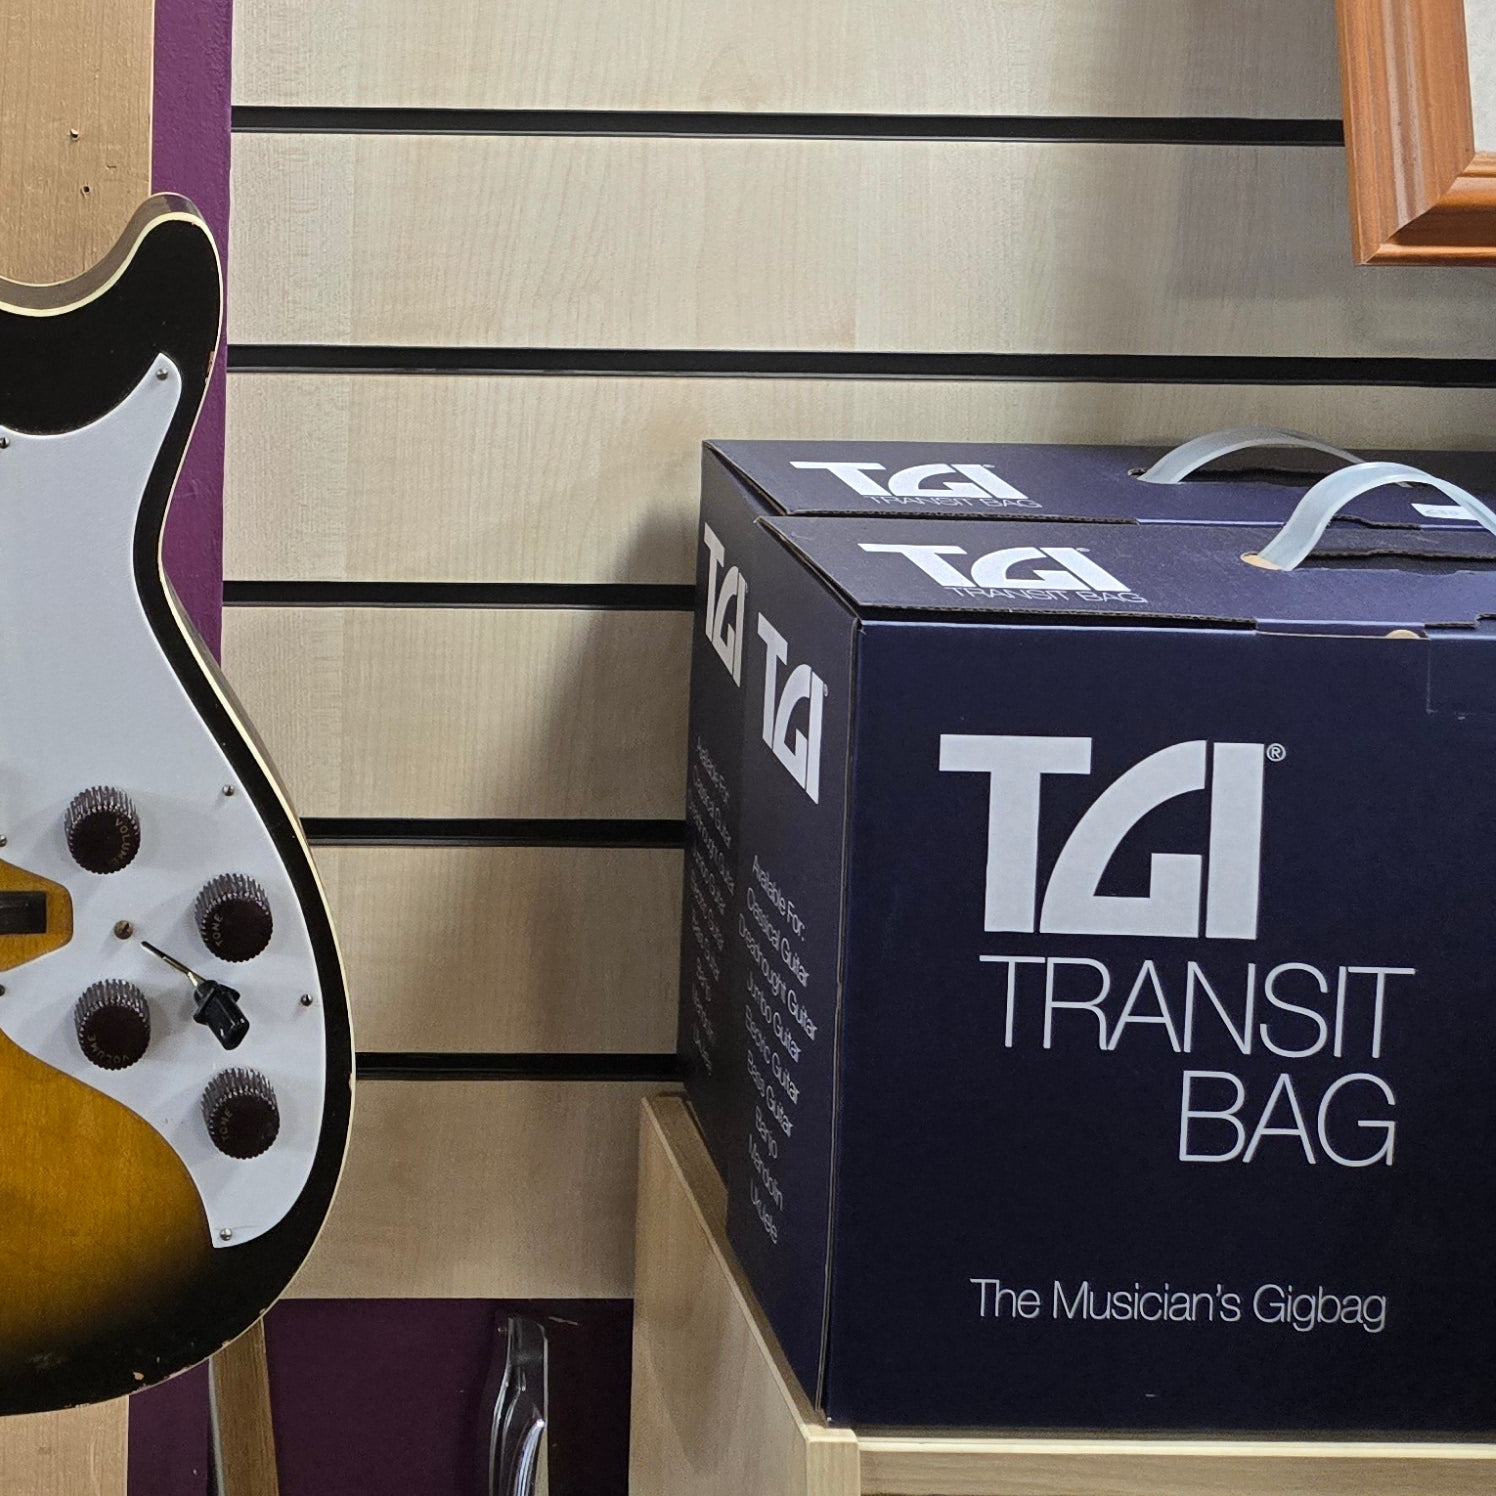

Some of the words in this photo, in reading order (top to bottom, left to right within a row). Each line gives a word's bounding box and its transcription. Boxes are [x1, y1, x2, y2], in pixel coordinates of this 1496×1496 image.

[789, 461, 1029, 501] TGI
[865, 495, 974, 508] TRANSIT
[979, 496, 1042, 509] BAG
[857, 543, 1132, 592] TGI
[704, 521, 746, 688] TGI
[944, 586, 1070, 602] TRANSIT
[1071, 589, 1149, 604] BAG
[757, 612, 824, 805] TGI
[939, 733, 1265, 940] TGI
[211, 913, 223, 947] TONE
[781, 938, 809, 988] Guitar
[788, 989, 818, 1041] Guitar
[979, 954, 1416, 1060] TRANSIT
[773, 1012, 802, 1063] Guitar
[772, 1053, 800, 1104] Guitar
[766, 1085, 794, 1137] Guitar
[1179, 1069, 1396, 1167] BAG
[970, 1278, 1041, 1319] The
[1052, 1280, 1241, 1322] Musician's
[1253, 1283, 1387, 1334] Gigbag
